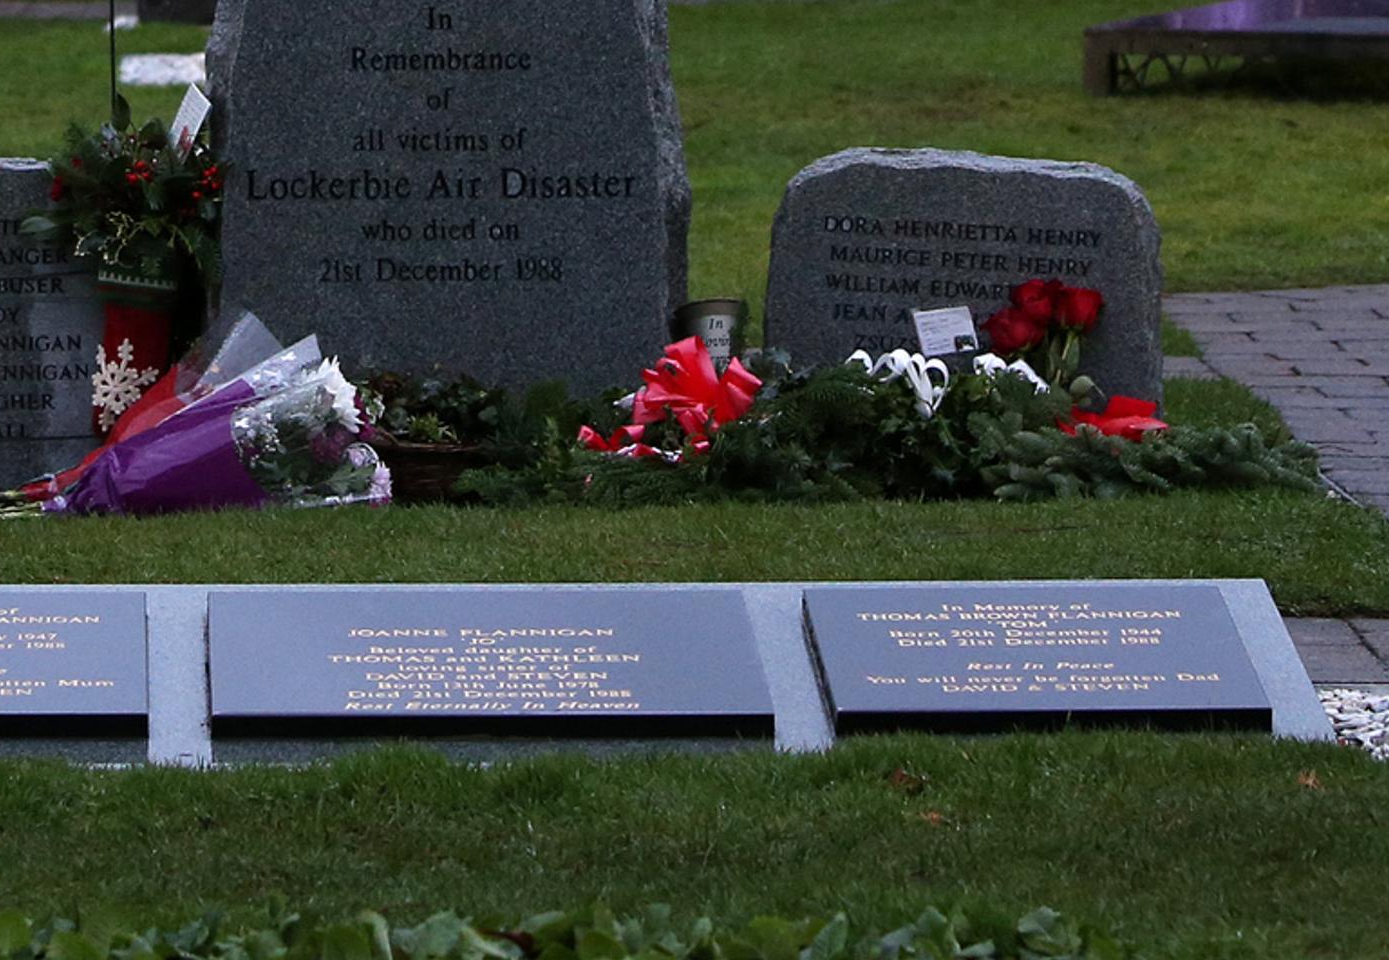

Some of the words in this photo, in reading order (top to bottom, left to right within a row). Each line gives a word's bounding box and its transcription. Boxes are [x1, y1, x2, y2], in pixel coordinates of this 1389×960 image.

[426, 6, 453, 31] In
[351, 47, 532, 71] Remembrance
[426, 88, 452, 112] of
[352, 128, 384, 151] all
[397, 128, 489, 151] victims
[500, 127, 529, 151] of
[246, 169, 411, 201] Lockerbie
[427, 168, 482, 200] Air
[501, 167, 636, 200] Disaster
[362, 219, 411, 242] who
[423, 216, 476, 242] died
[488, 222, 520, 242] on
[824, 214, 883, 236] DORA
[894, 219, 1016, 242] HENRIETTA
[1028, 227, 1102, 249] HENRY
[830, 246, 930, 268] MAURICE
[941, 251, 1009, 272] PETER
[1019, 256, 1092, 277] HENRY
[319, 258, 361, 283] 21st
[376, 256, 503, 283] December
[515, 256, 563, 282] 1988
[825, 273, 920, 295] WILLIAM
[832, 302, 886, 322] JEAN
[942, 604, 963, 612] In
[973, 603, 1060, 612] Memory
[1069, 602, 1092, 611] of
[856, 613, 950, 621] THOMAS
[959, 612, 1038, 621] BROWN
[1048, 611, 1181, 620] FLANNIGAN
[18, 632, 58, 641] 1947
[347, 628, 448, 638] JOANNE
[460, 628, 613, 637] FLANNIGAN
[888, 630, 940, 638] Born
[1006, 629, 1110, 637] December
[26, 641, 66, 649] 1988
[898, 638, 948, 647] Died
[958, 638, 994, 647] 21st
[1005, 637, 1110, 646] December
[1120, 636, 1161, 645] 1988
[369, 645, 454, 654] Beloved
[465, 645, 562, 656] daughter
[573, 645, 597, 654] of
[327, 654, 436, 664] THOMAS
[446, 654, 487, 663] and
[499, 653, 640, 663] KATHLEEN
[398, 663, 467, 673] loving
[478, 663, 537, 672] sister
[548, 663, 573, 672] of
[966, 661, 1012, 670] Rest
[1022, 661, 1044, 670] In
[1056, 660, 1116, 670] Peace
[365, 672, 445, 681] DAVID
[456, 672, 497, 680] and
[508, 671, 608, 680] STEVEN
[866, 676, 907, 684] You
[917, 675, 957, 684] will
[967, 675, 1025, 683] never
[1034, 674, 1058, 683] be
[1069, 674, 1167, 683] forgotten
[1176, 672, 1220, 681] Dad
[57, 679, 115, 687] Mum
[377, 681, 431, 689] Born
[496, 681, 547, 689] June
[942, 684, 1018, 693] DAVID
[1028, 683, 1043, 692] &
[1054, 682, 1150, 692] STEVEN
[347, 690, 400, 699] Died
[412, 690, 451, 699] 21st
[463, 690, 578, 698] December
[344, 701, 394, 710] Rest
[404, 701, 512, 711] Eternally
[522, 701, 545, 710] In
[557, 701, 640, 710] Heaven
